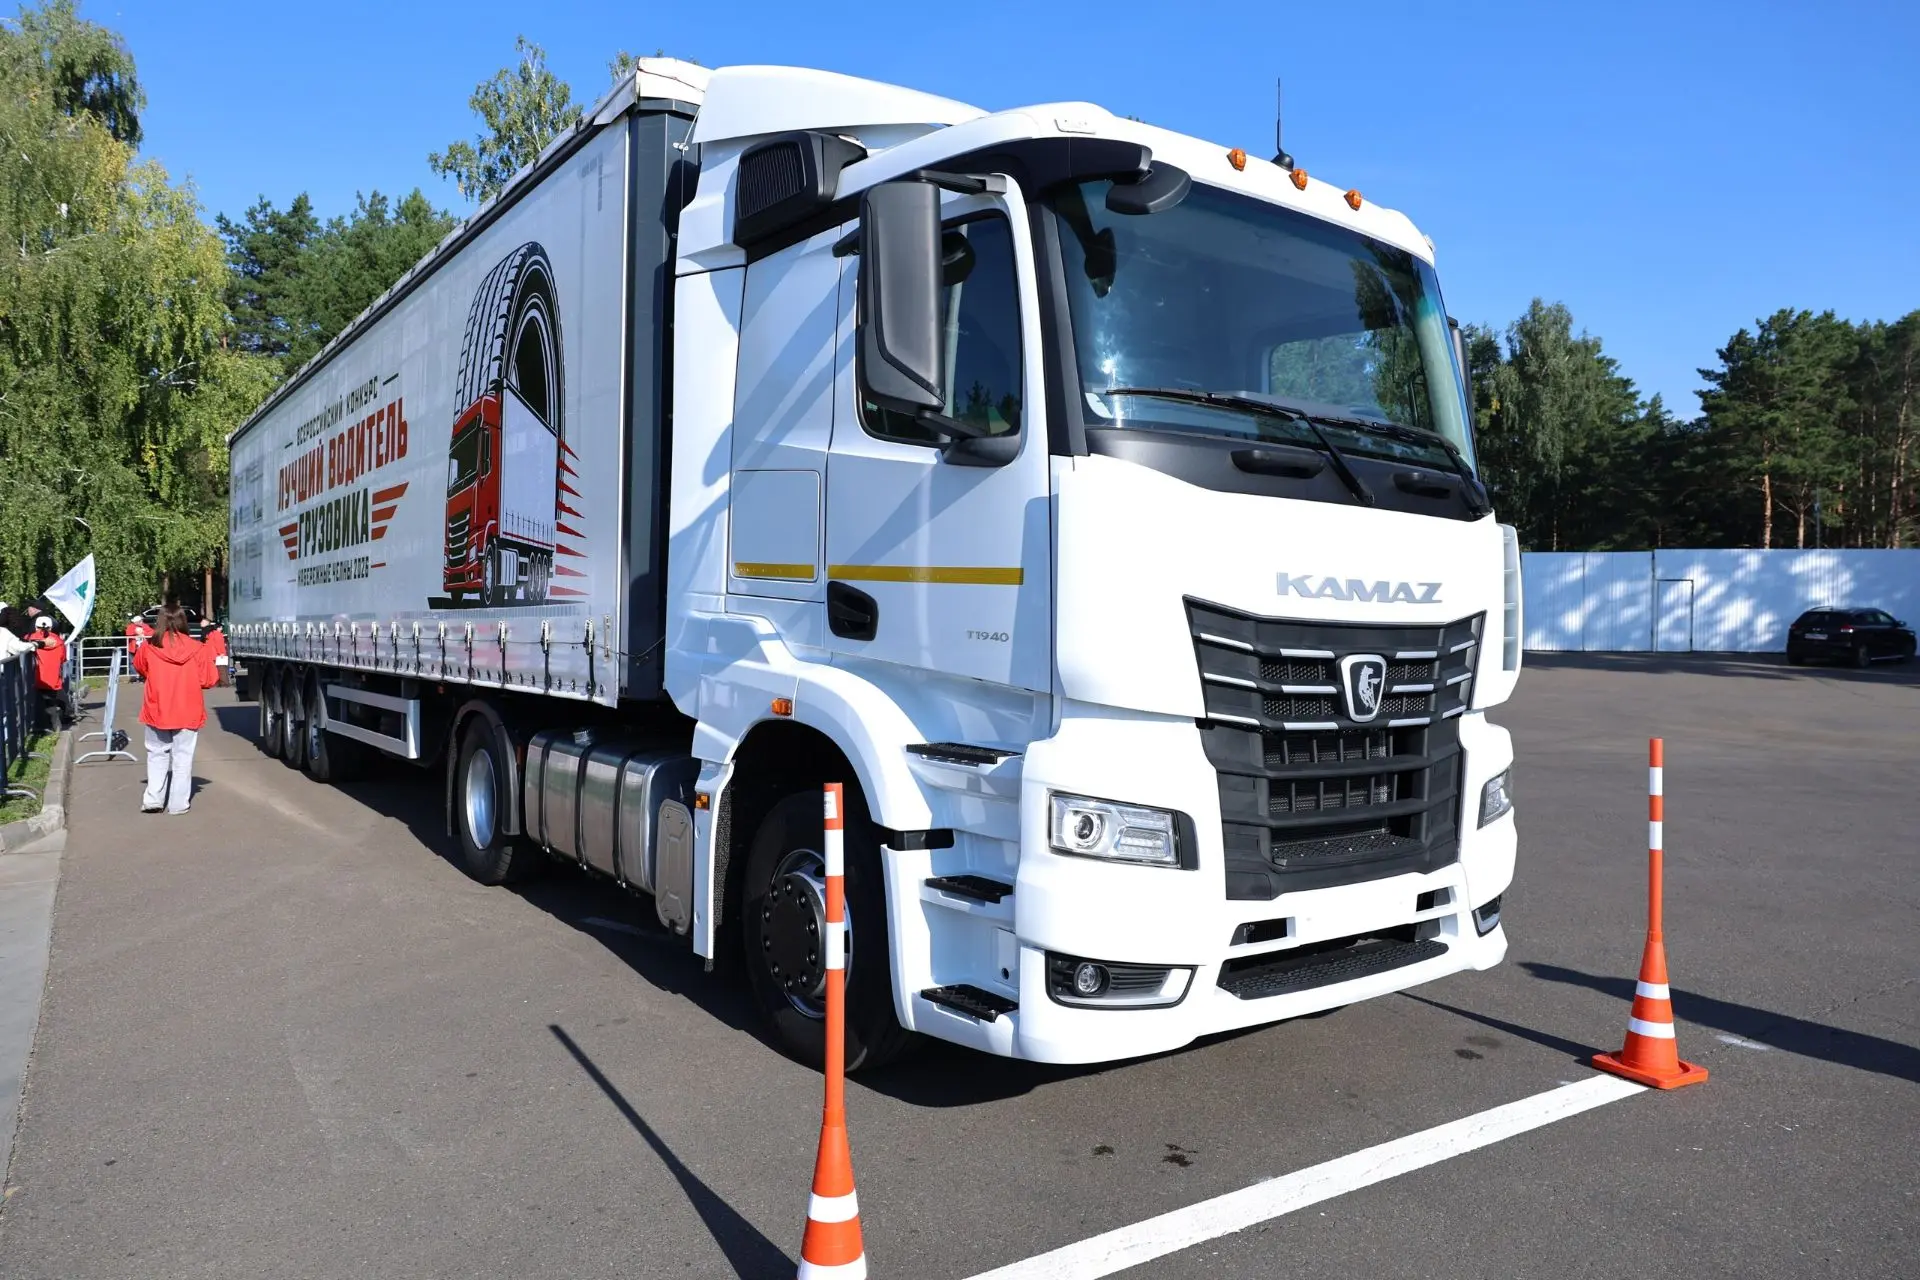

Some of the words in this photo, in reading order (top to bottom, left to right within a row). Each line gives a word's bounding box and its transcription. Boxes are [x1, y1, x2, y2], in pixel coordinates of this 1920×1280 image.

[346, 375, 378, 417] КОНКУРС
[278, 438, 324, 512] ЛУЧШИЙ
[328, 397, 408, 490] ВОДИТЕЛЬ
[298, 488, 369, 559] ГРУЗОВИКА
[1276, 572, 1443, 604] KAMAZ
[966, 629, 1010, 643] T1940
